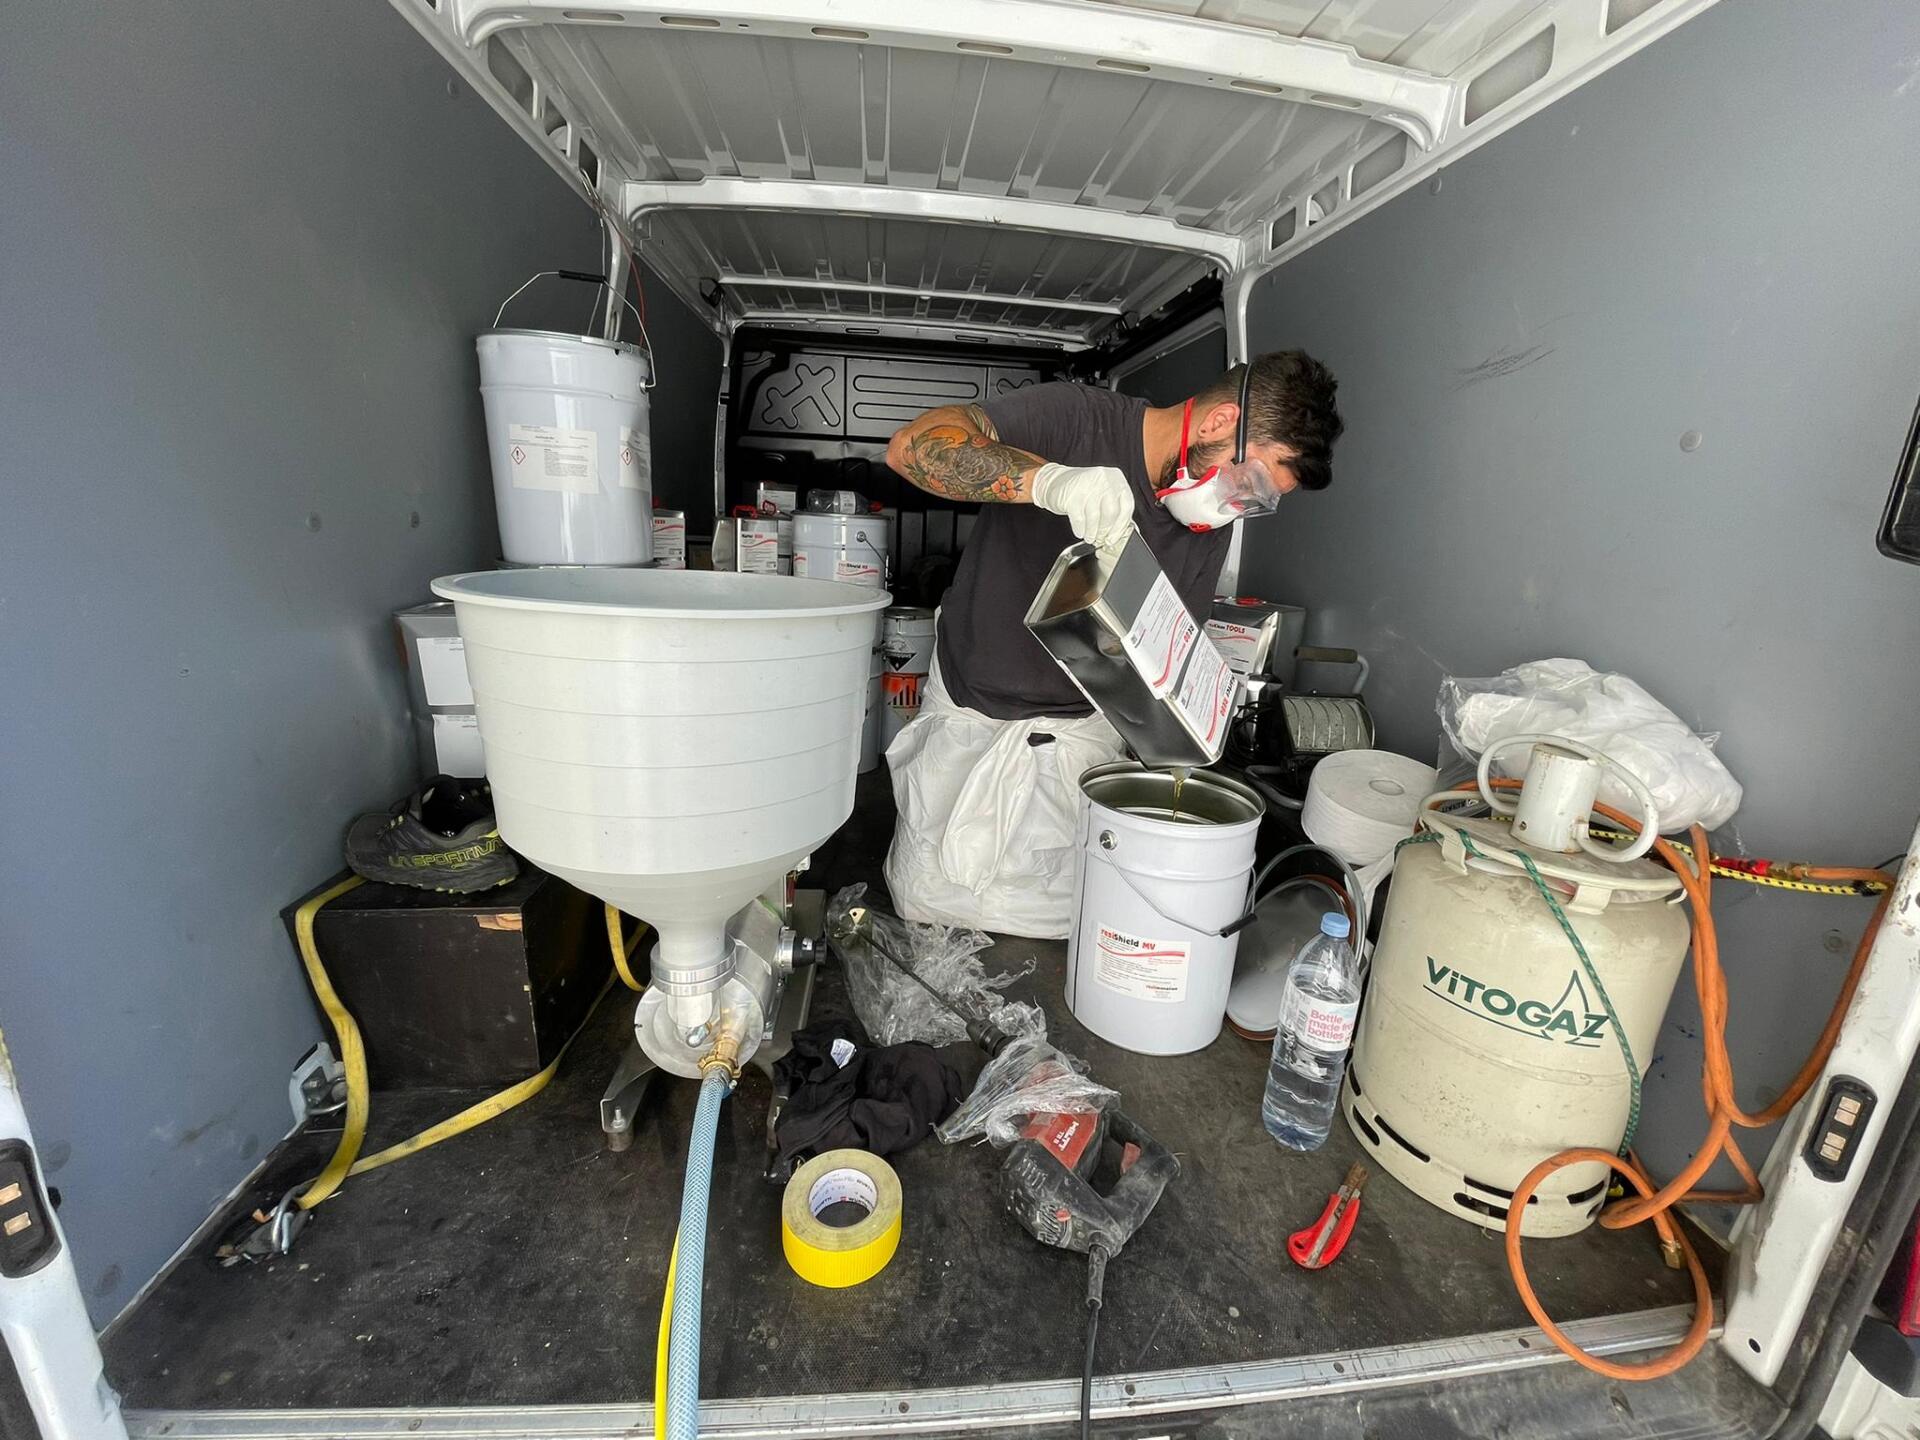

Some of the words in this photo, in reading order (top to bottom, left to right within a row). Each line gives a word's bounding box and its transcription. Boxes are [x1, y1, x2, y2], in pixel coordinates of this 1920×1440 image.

[1226, 624, 1246, 634] TOOLS
[1100, 928, 1140, 948] resiShield
[1141, 942, 1156, 951] MV
[1310, 1008, 1343, 1024] Bottle
[1308, 1019, 1341, 1032] made
[1308, 1023, 1345, 1041] bottles
